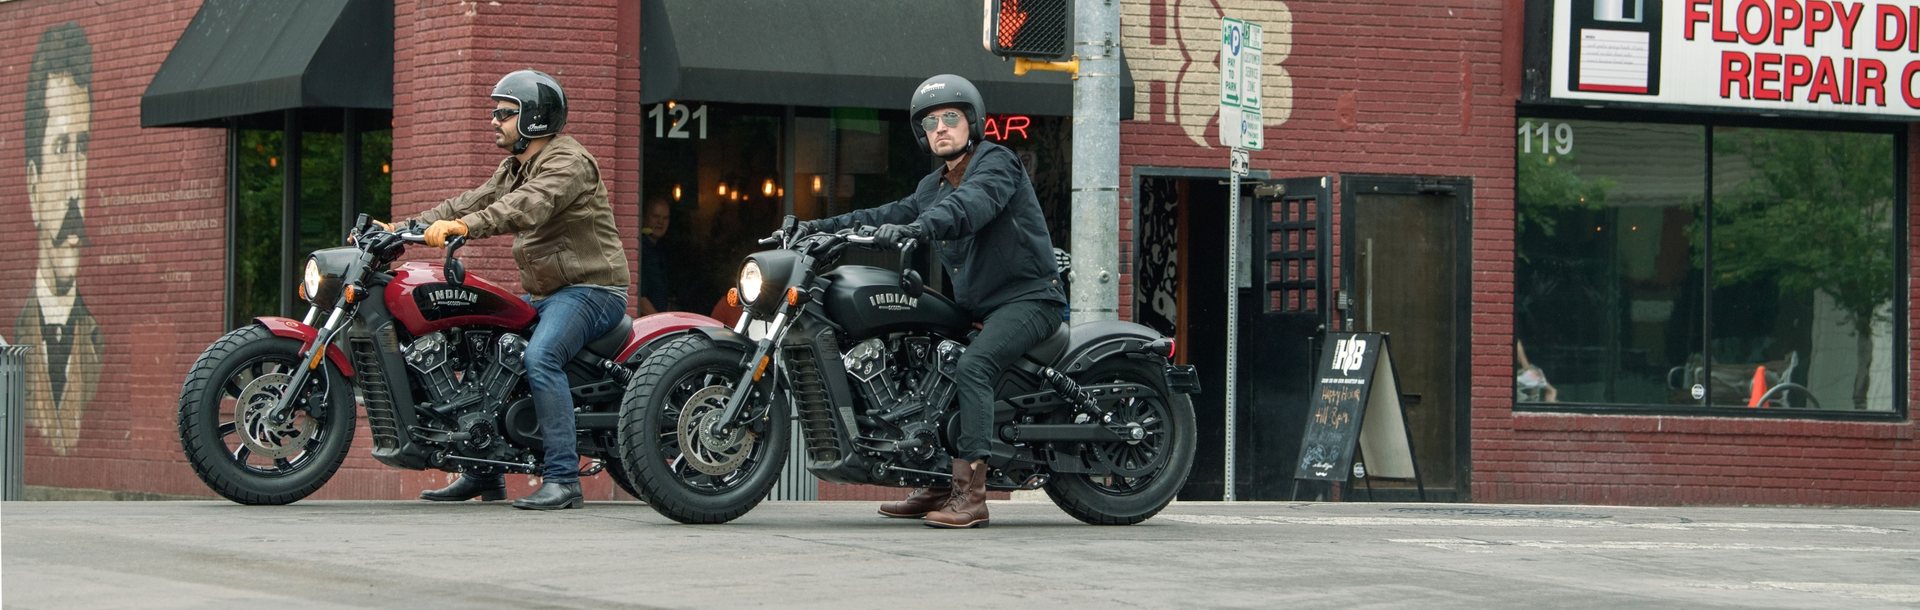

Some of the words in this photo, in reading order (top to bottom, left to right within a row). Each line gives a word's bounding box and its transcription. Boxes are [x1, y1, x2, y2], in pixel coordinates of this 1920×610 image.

[1684, 0, 1864, 49] FLOPPY
[1227, 57, 1236, 67] PAY
[1228, 69, 1235, 78] TO
[1720, 50, 1887, 107] REPAIR
[1225, 81, 1237, 91] PARK
[648, 103, 708, 139] 121
[1518, 121, 1574, 155] 119
[428, 289, 478, 303] INDIAN
[869, 293, 918, 308] INDIAN
